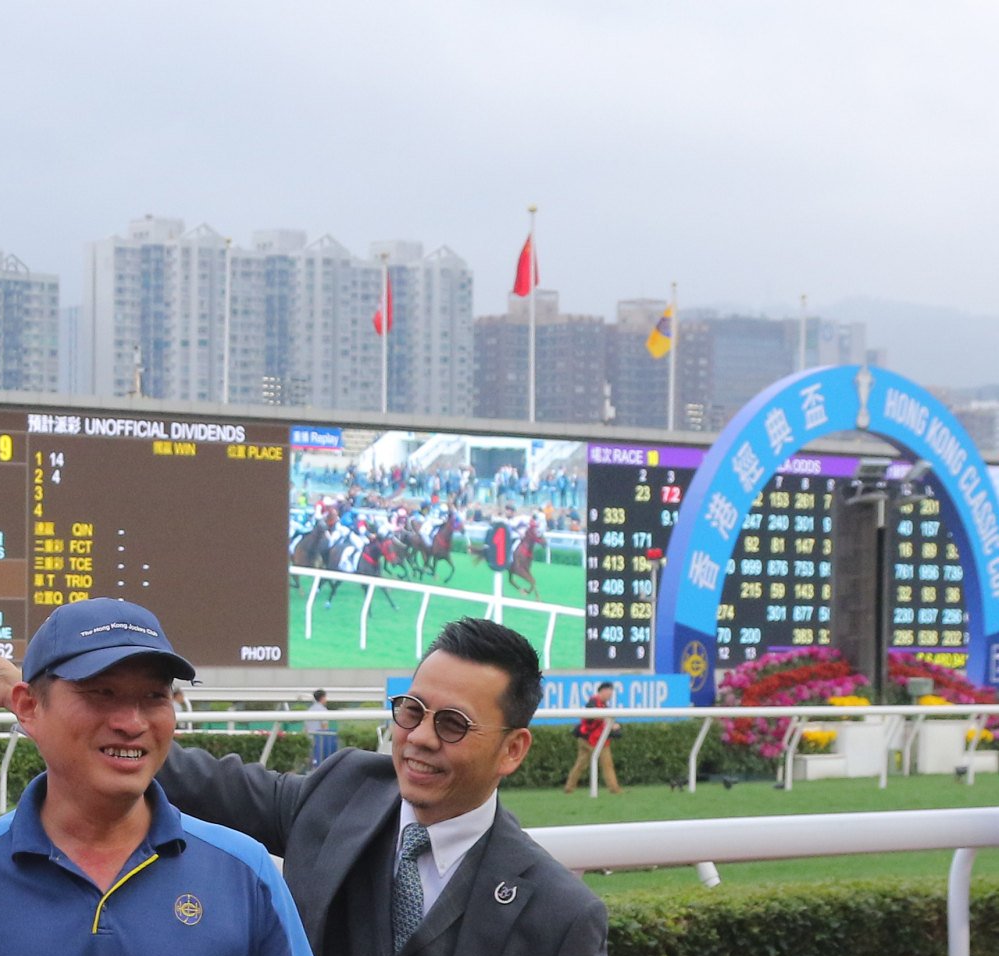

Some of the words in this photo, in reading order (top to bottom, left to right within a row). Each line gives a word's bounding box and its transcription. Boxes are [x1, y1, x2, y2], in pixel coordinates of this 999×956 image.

[84, 417, 168, 440] UNOFFICIAL
[171, 422, 246, 443] DIVIDENDS
[310, 431, 339, 446] Replay
[35, 451, 43, 466] 1
[50, 452, 65, 467] 14
[174, 441, 196, 456] WIN
[248, 446, 283, 461] PLACE
[613, 449, 644, 465] RACE
[34, 469, 43, 483] 2
[51, 469, 61, 484] 4
[639, 469, 647, 482] 2
[667, 470, 675, 483] 3
[775, 475, 783, 489] 7
[801, 477, 809, 490] 8
[827, 478, 835, 491] 9
[34, 485, 43, 500] 3
[635, 485, 651, 501] 23
[884, 387, 929, 437] HONG
[925, 415, 969, 476] KONG
[958, 465, 999, 555] CLASSIC
[987, 556, 999, 598] CU
[34, 503, 43, 517] 4
[590, 508, 598, 522] 9
[603, 508, 625, 524] 333
[72, 523, 93, 537] QIN
[69, 540, 92, 554] FCT
[589, 532, 600, 545] 10
[602, 531, 625, 547] 464
[632, 532, 652, 547] 171
[69, 557, 93, 571] TCE
[588, 557, 598, 569] 11
[602, 555, 625, 572] 413
[65, 574, 92, 588] TRIO
[588, 580, 599, 593] 12
[602, 579, 624, 595] 408
[587, 604, 599, 617] 13
[602, 602, 624, 618] 426
[630, 603, 652, 619] 623
[587, 628, 598, 640] 14
[602, 626, 624, 642] 403
[630, 626, 650, 642] 341
[241, 646, 281, 661] PHOTO
[608, 645, 616, 659] 8
[637, 646, 645, 659] 9
[630, 680, 669, 709] CUP
